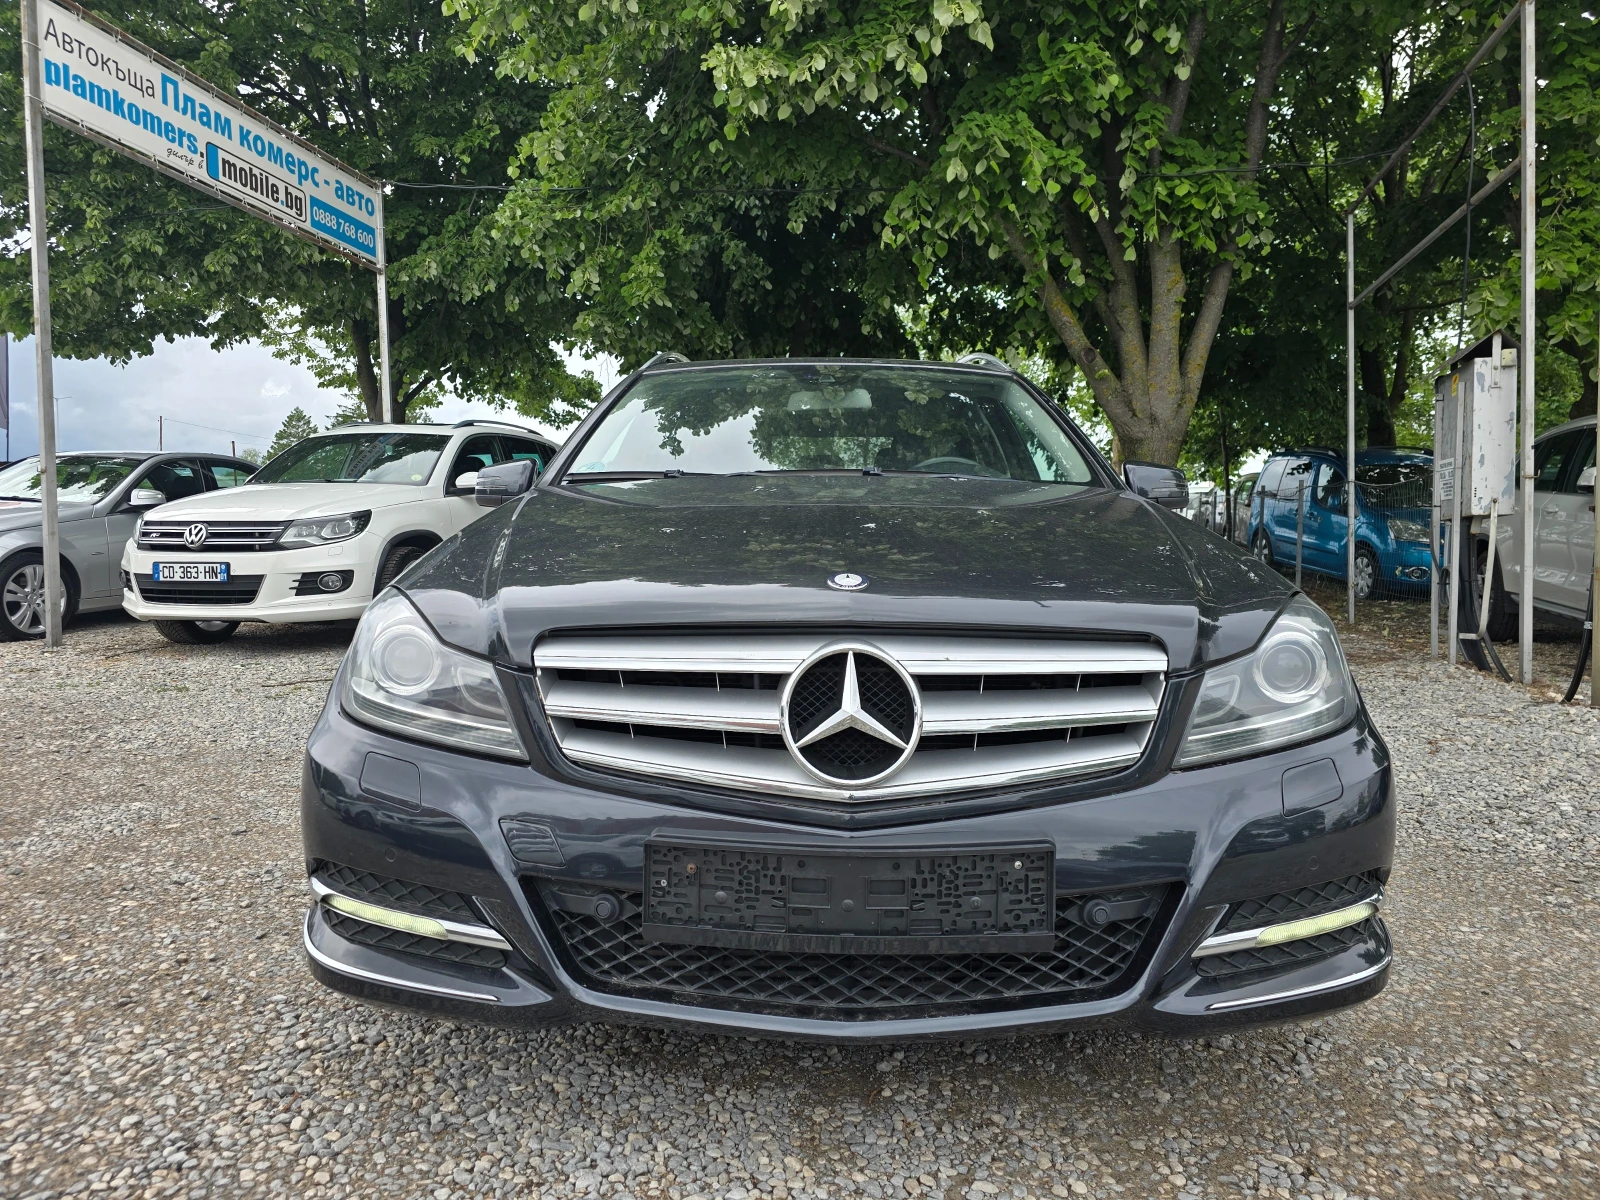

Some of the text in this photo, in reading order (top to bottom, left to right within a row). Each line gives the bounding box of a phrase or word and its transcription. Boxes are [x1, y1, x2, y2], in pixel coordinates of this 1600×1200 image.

[44, 17, 156, 99] Автокъща
[160, 72, 233, 140] Плам
[238, 124, 320, 187] комерс
[334, 179, 375, 217] авто
[221, 156, 303, 218] mobile.bg
[312, 206, 374, 249] 0888 768 600
